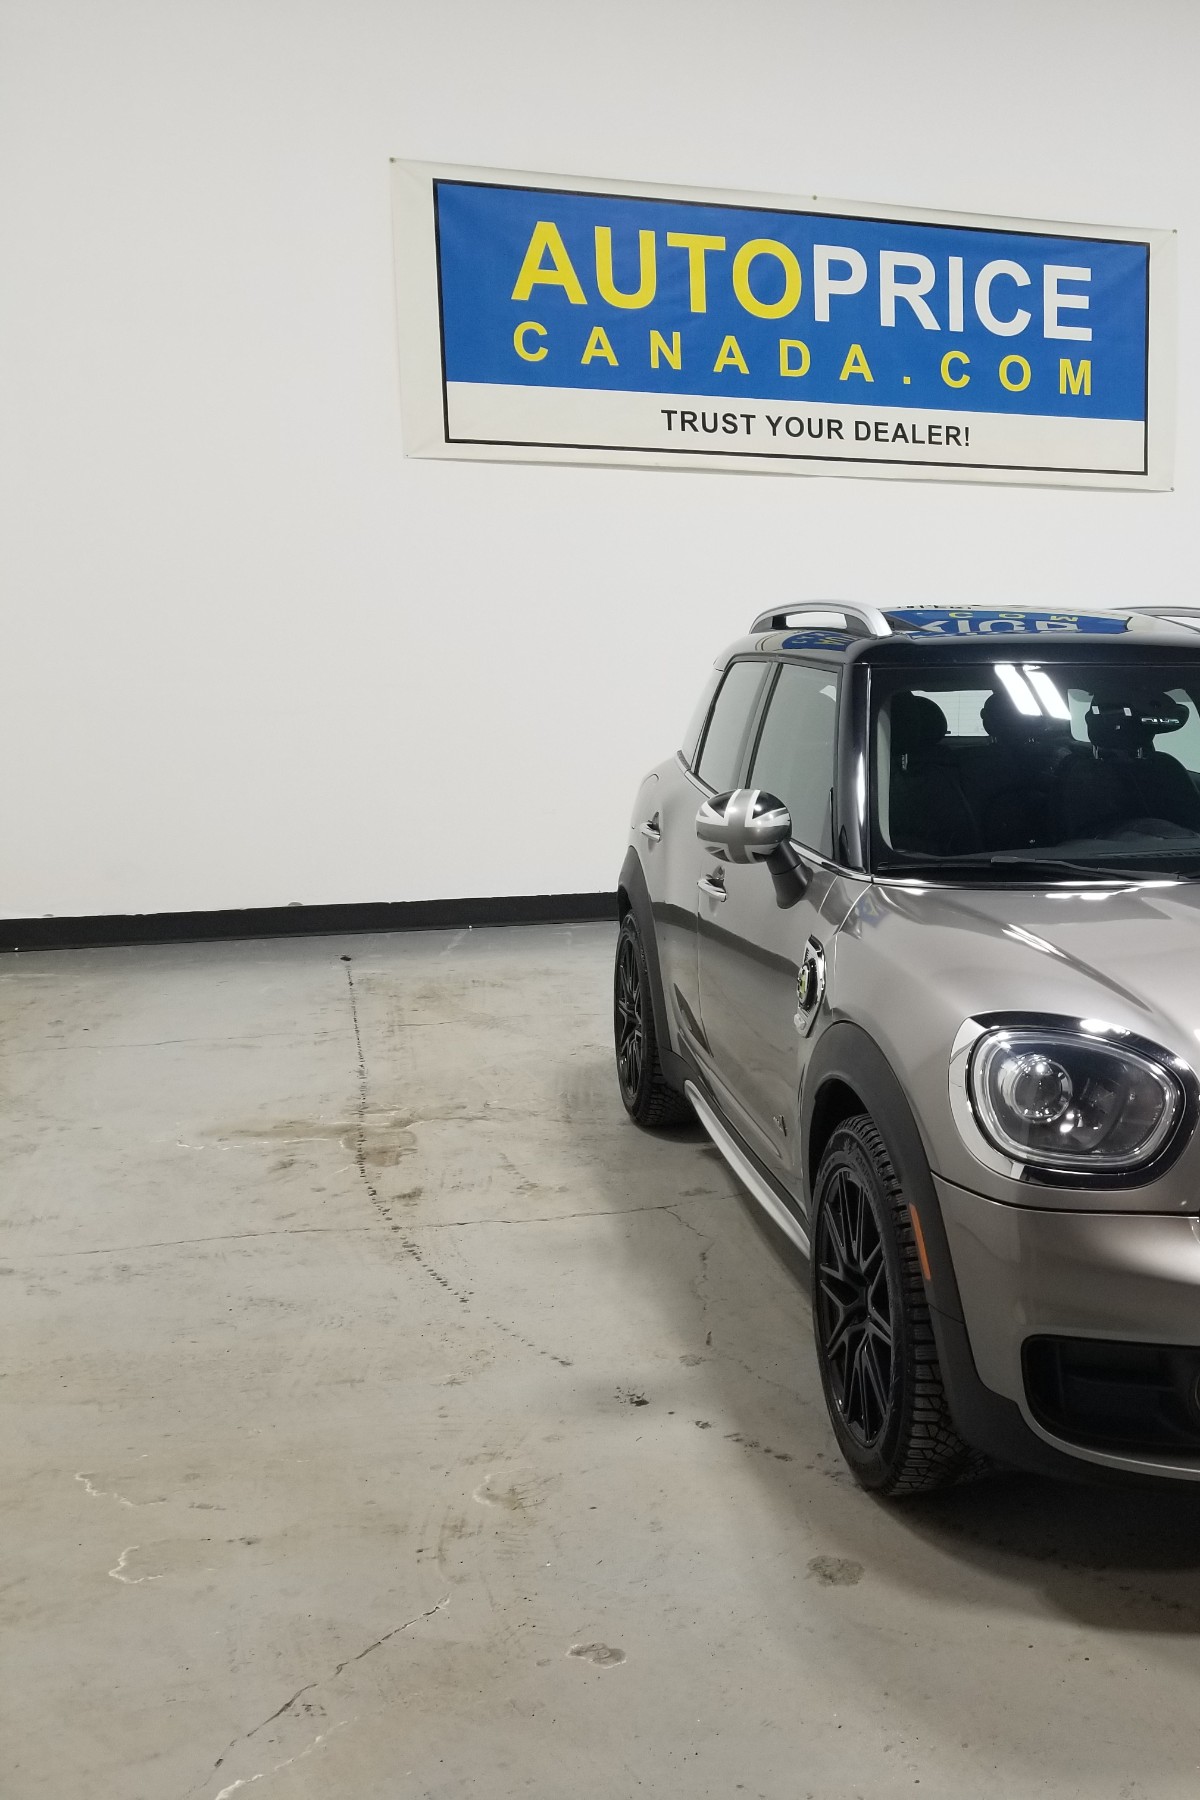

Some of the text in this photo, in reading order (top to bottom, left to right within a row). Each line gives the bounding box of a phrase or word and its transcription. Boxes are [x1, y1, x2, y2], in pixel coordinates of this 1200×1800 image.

[510, 220, 1093, 342] AUTOPRICE
[513, 320, 1092, 396] CANADA.COM
[660, 409, 971, 447] TRUST YOUR DEALER!
